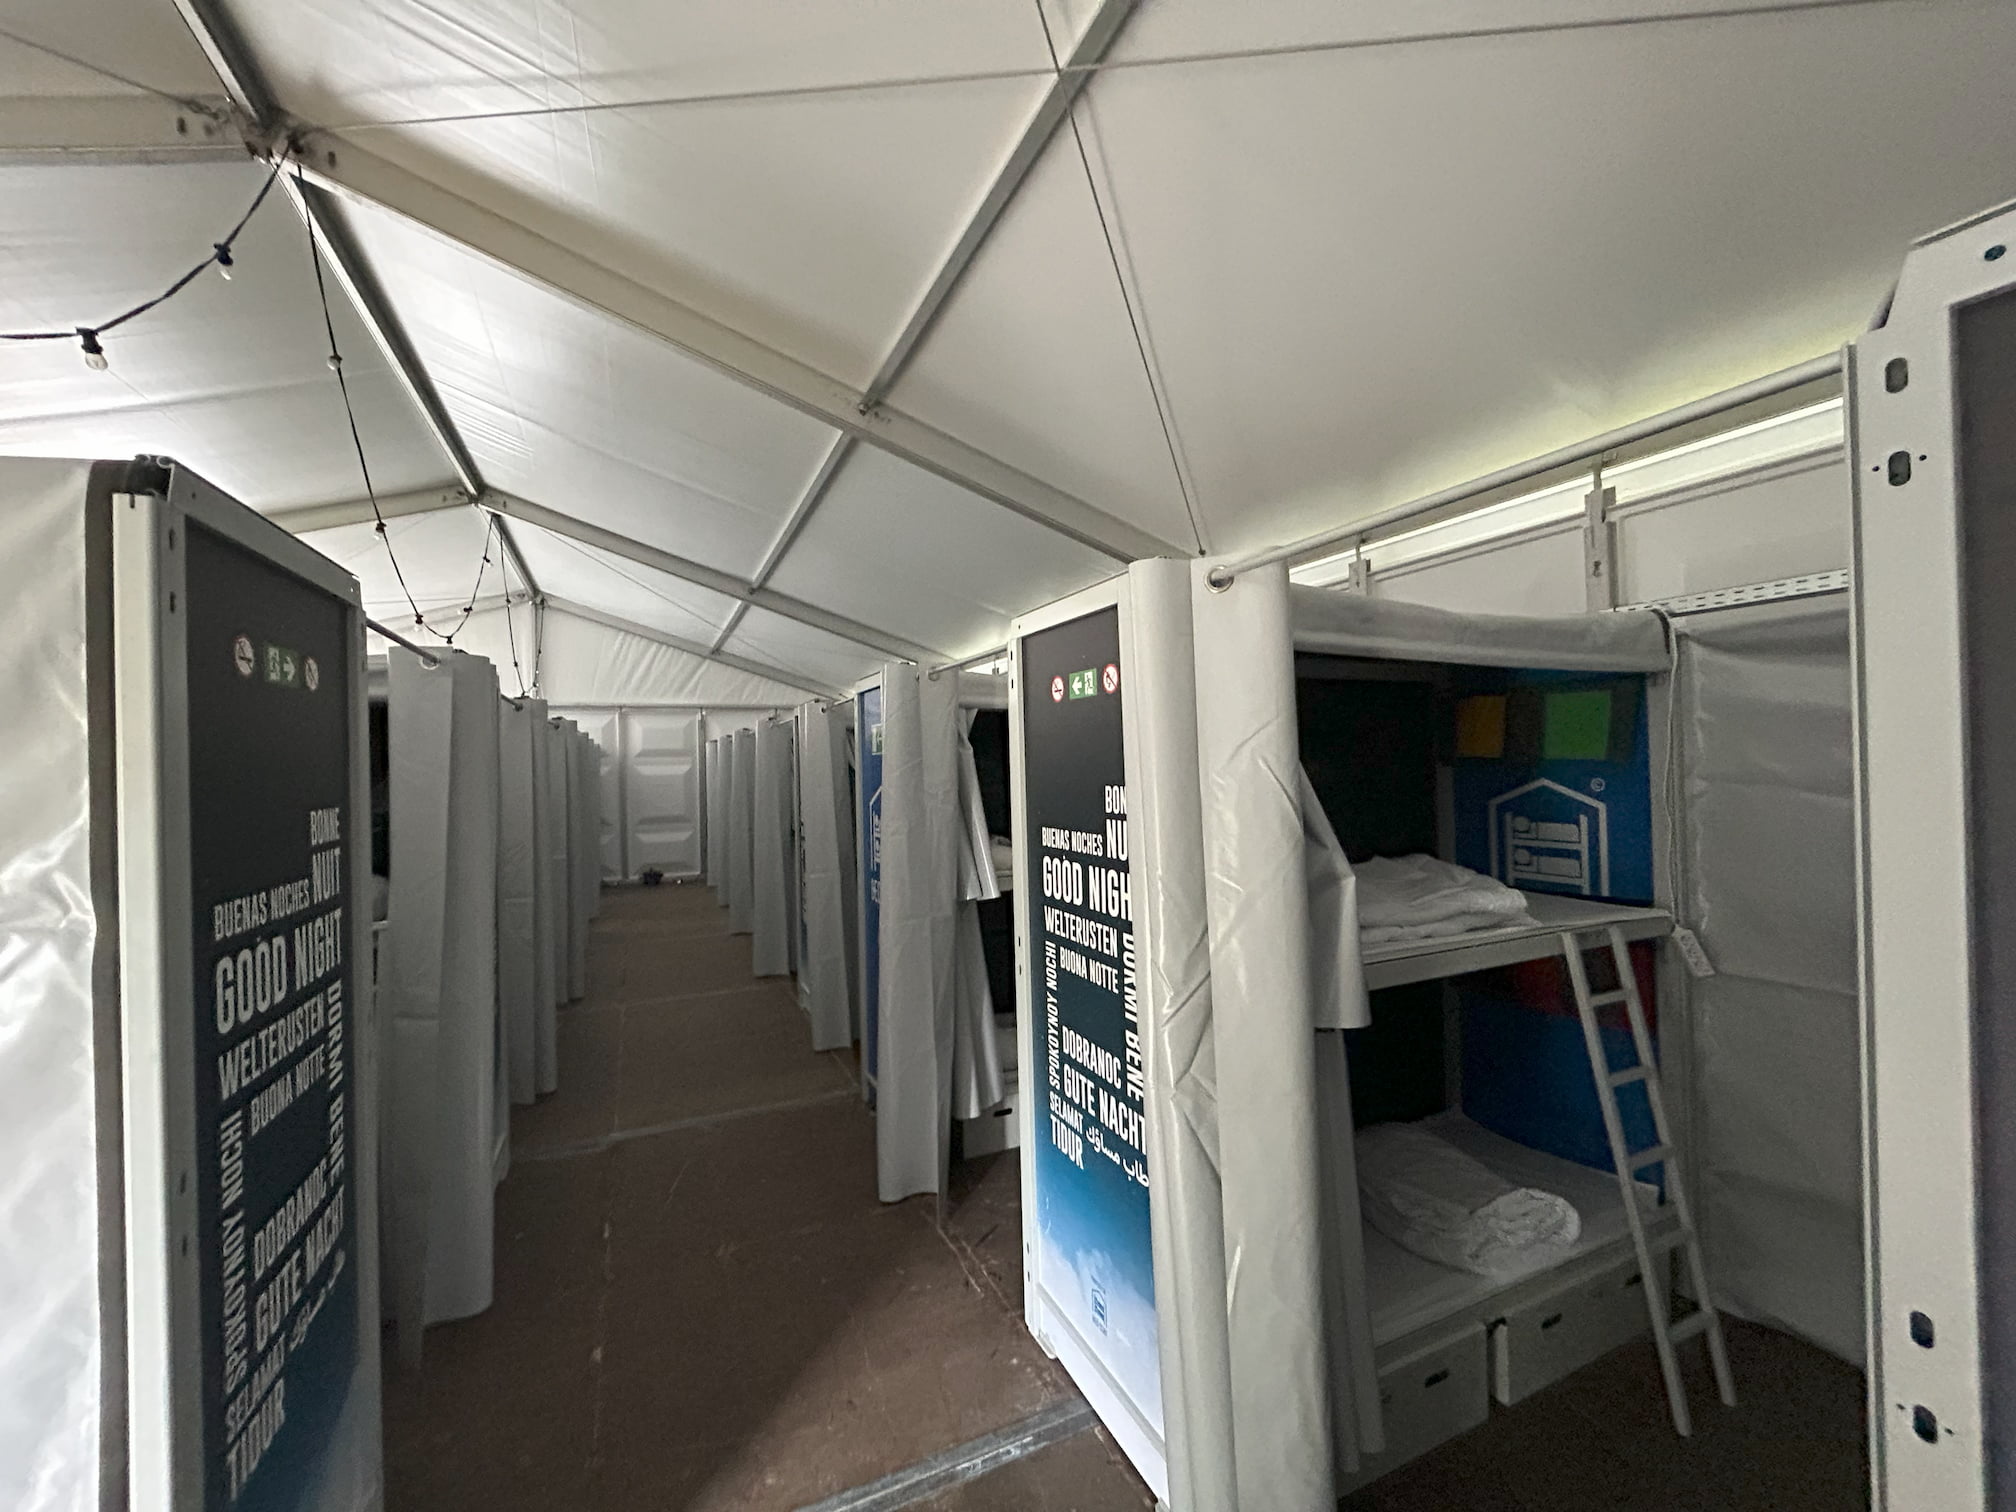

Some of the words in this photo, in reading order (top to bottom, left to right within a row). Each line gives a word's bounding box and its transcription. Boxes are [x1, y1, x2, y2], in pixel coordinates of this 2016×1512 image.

[310, 807, 340, 846] BONNE
[1105, 785, 1128, 815] BON
[1041, 826, 1070, 851] BUENAS
[1071, 831, 1103, 857] NOCHES
[1106, 819, 1129, 861] NU
[312, 847, 341, 905] NUIT
[1042, 855, 1083, 907] GOOD
[1088, 865, 1133, 922] NIGH
[214, 891, 268, 942] BUENAS
[270, 878, 310, 921] NOCHES
[1044, 904, 1119, 959] WELTERUSTEN
[215, 934, 287, 1035] GOOD
[294, 907, 342, 991] NIGHT
[1045, 940, 1058, 991] NOCHI
[1060, 945, 1088, 981] BUONA
[1089, 958, 1119, 995] NOTTE
[218, 991, 325, 1102] WELTERUSTEN
[328, 978, 343, 1091] DORMI
[1046, 991, 1061, 1091] SPOKOYNOY
[1062, 1024, 1122, 1090] DOBRANOC
[251, 1072, 293, 1137] BUONA
[296, 1043, 326, 1099] NOTTE
[1050, 1091, 1083, 1135] SELAMAT
[1063, 1063, 1096, 1117] GUTE
[1099, 1087, 1147, 1156] NACHT
[220, 1109, 244, 1210] NOCHI
[330, 1092, 344, 1188] BENE
[1050, 1116, 1084, 1171] TIDUR
[256, 1248, 301, 1352] GUTE
[306, 1184, 344, 1285] NACHT
[227, 1378, 286, 1500] TIDUR
